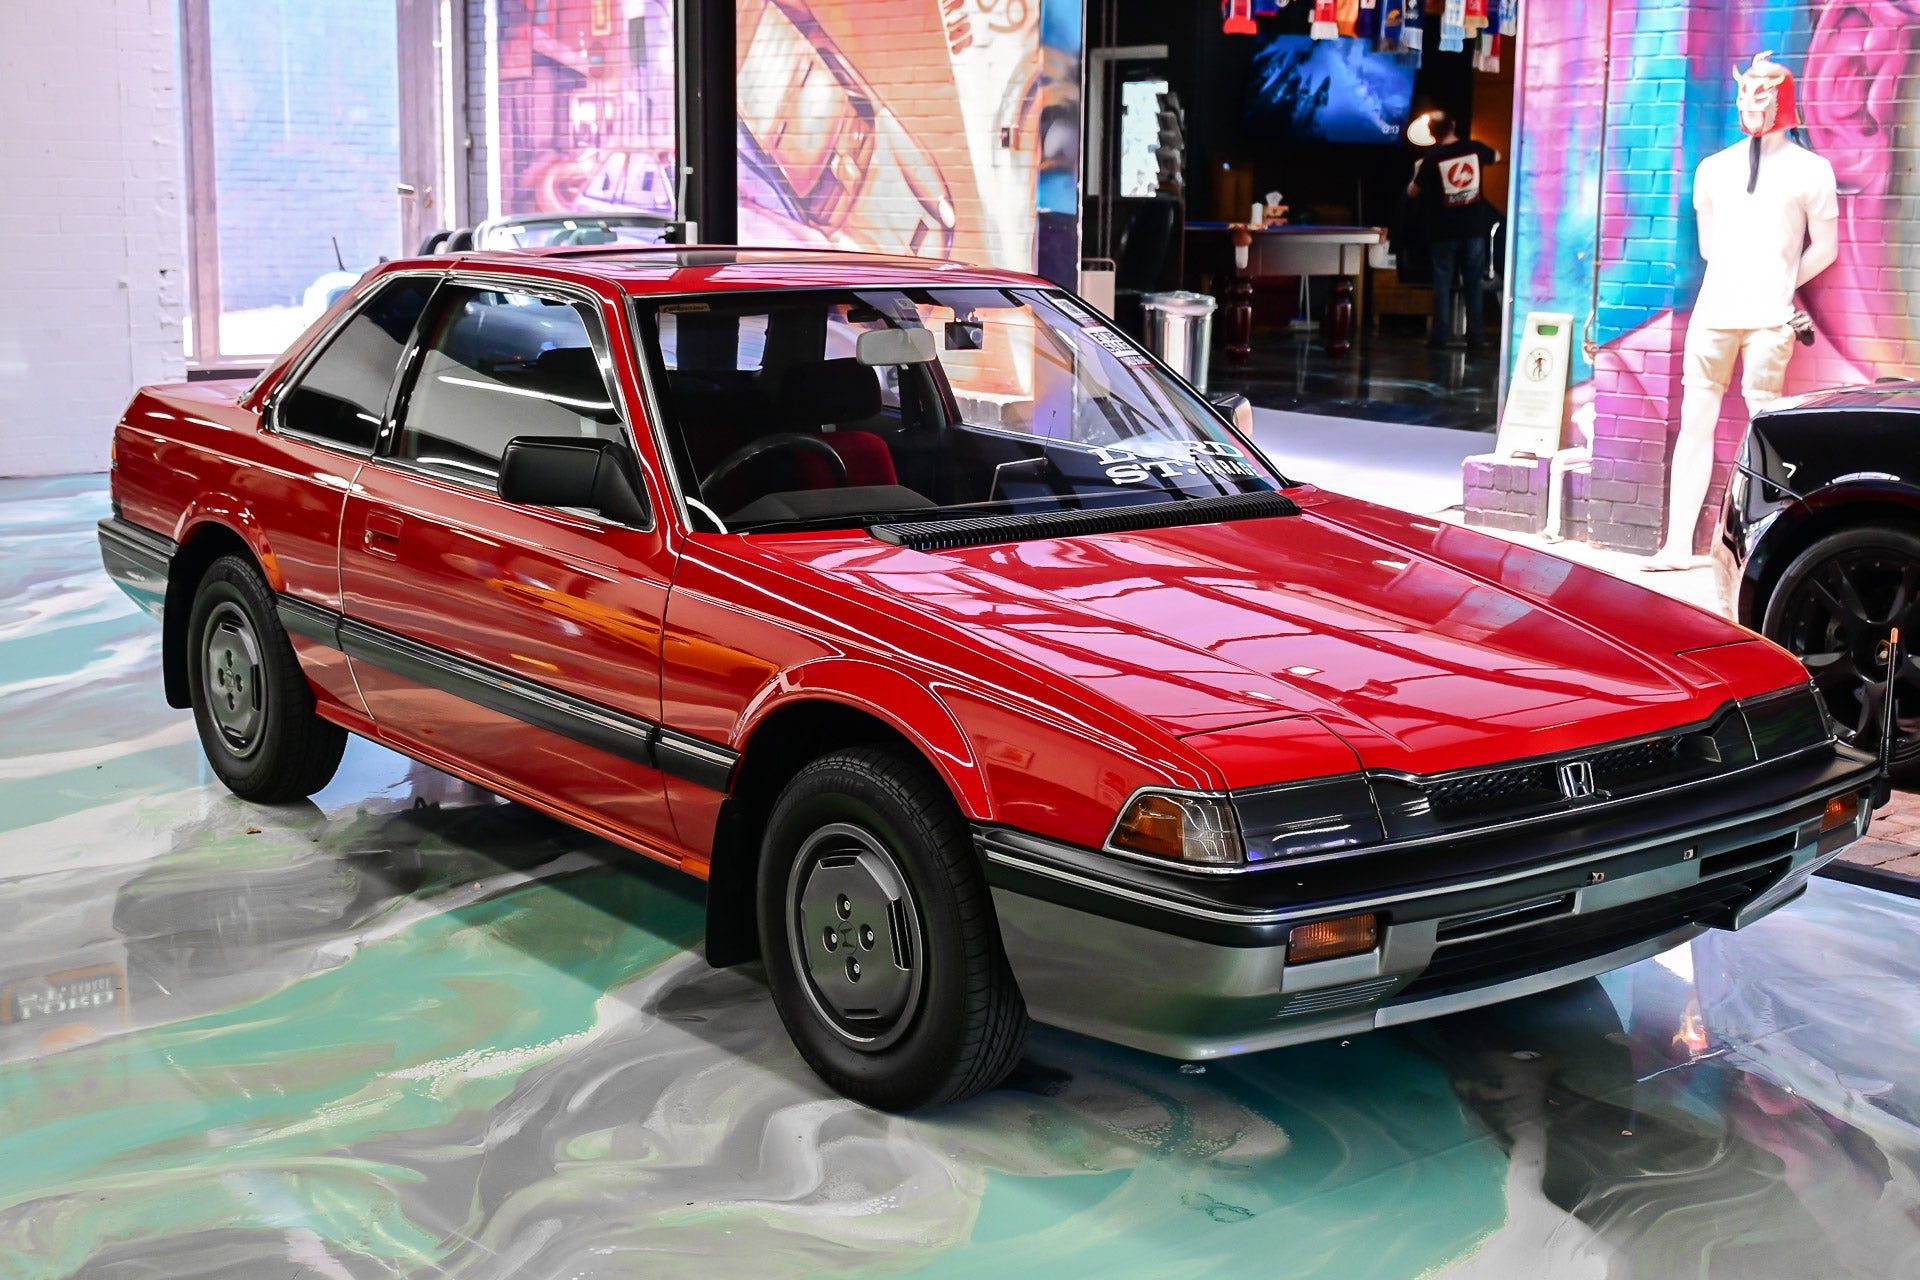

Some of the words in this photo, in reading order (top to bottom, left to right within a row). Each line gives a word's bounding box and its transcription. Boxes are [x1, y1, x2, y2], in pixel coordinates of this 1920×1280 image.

[1088, 440, 1245, 466] LRD
[1105, 459, 1198, 486] ST.
[1196, 459, 1263, 478] GARAGE
